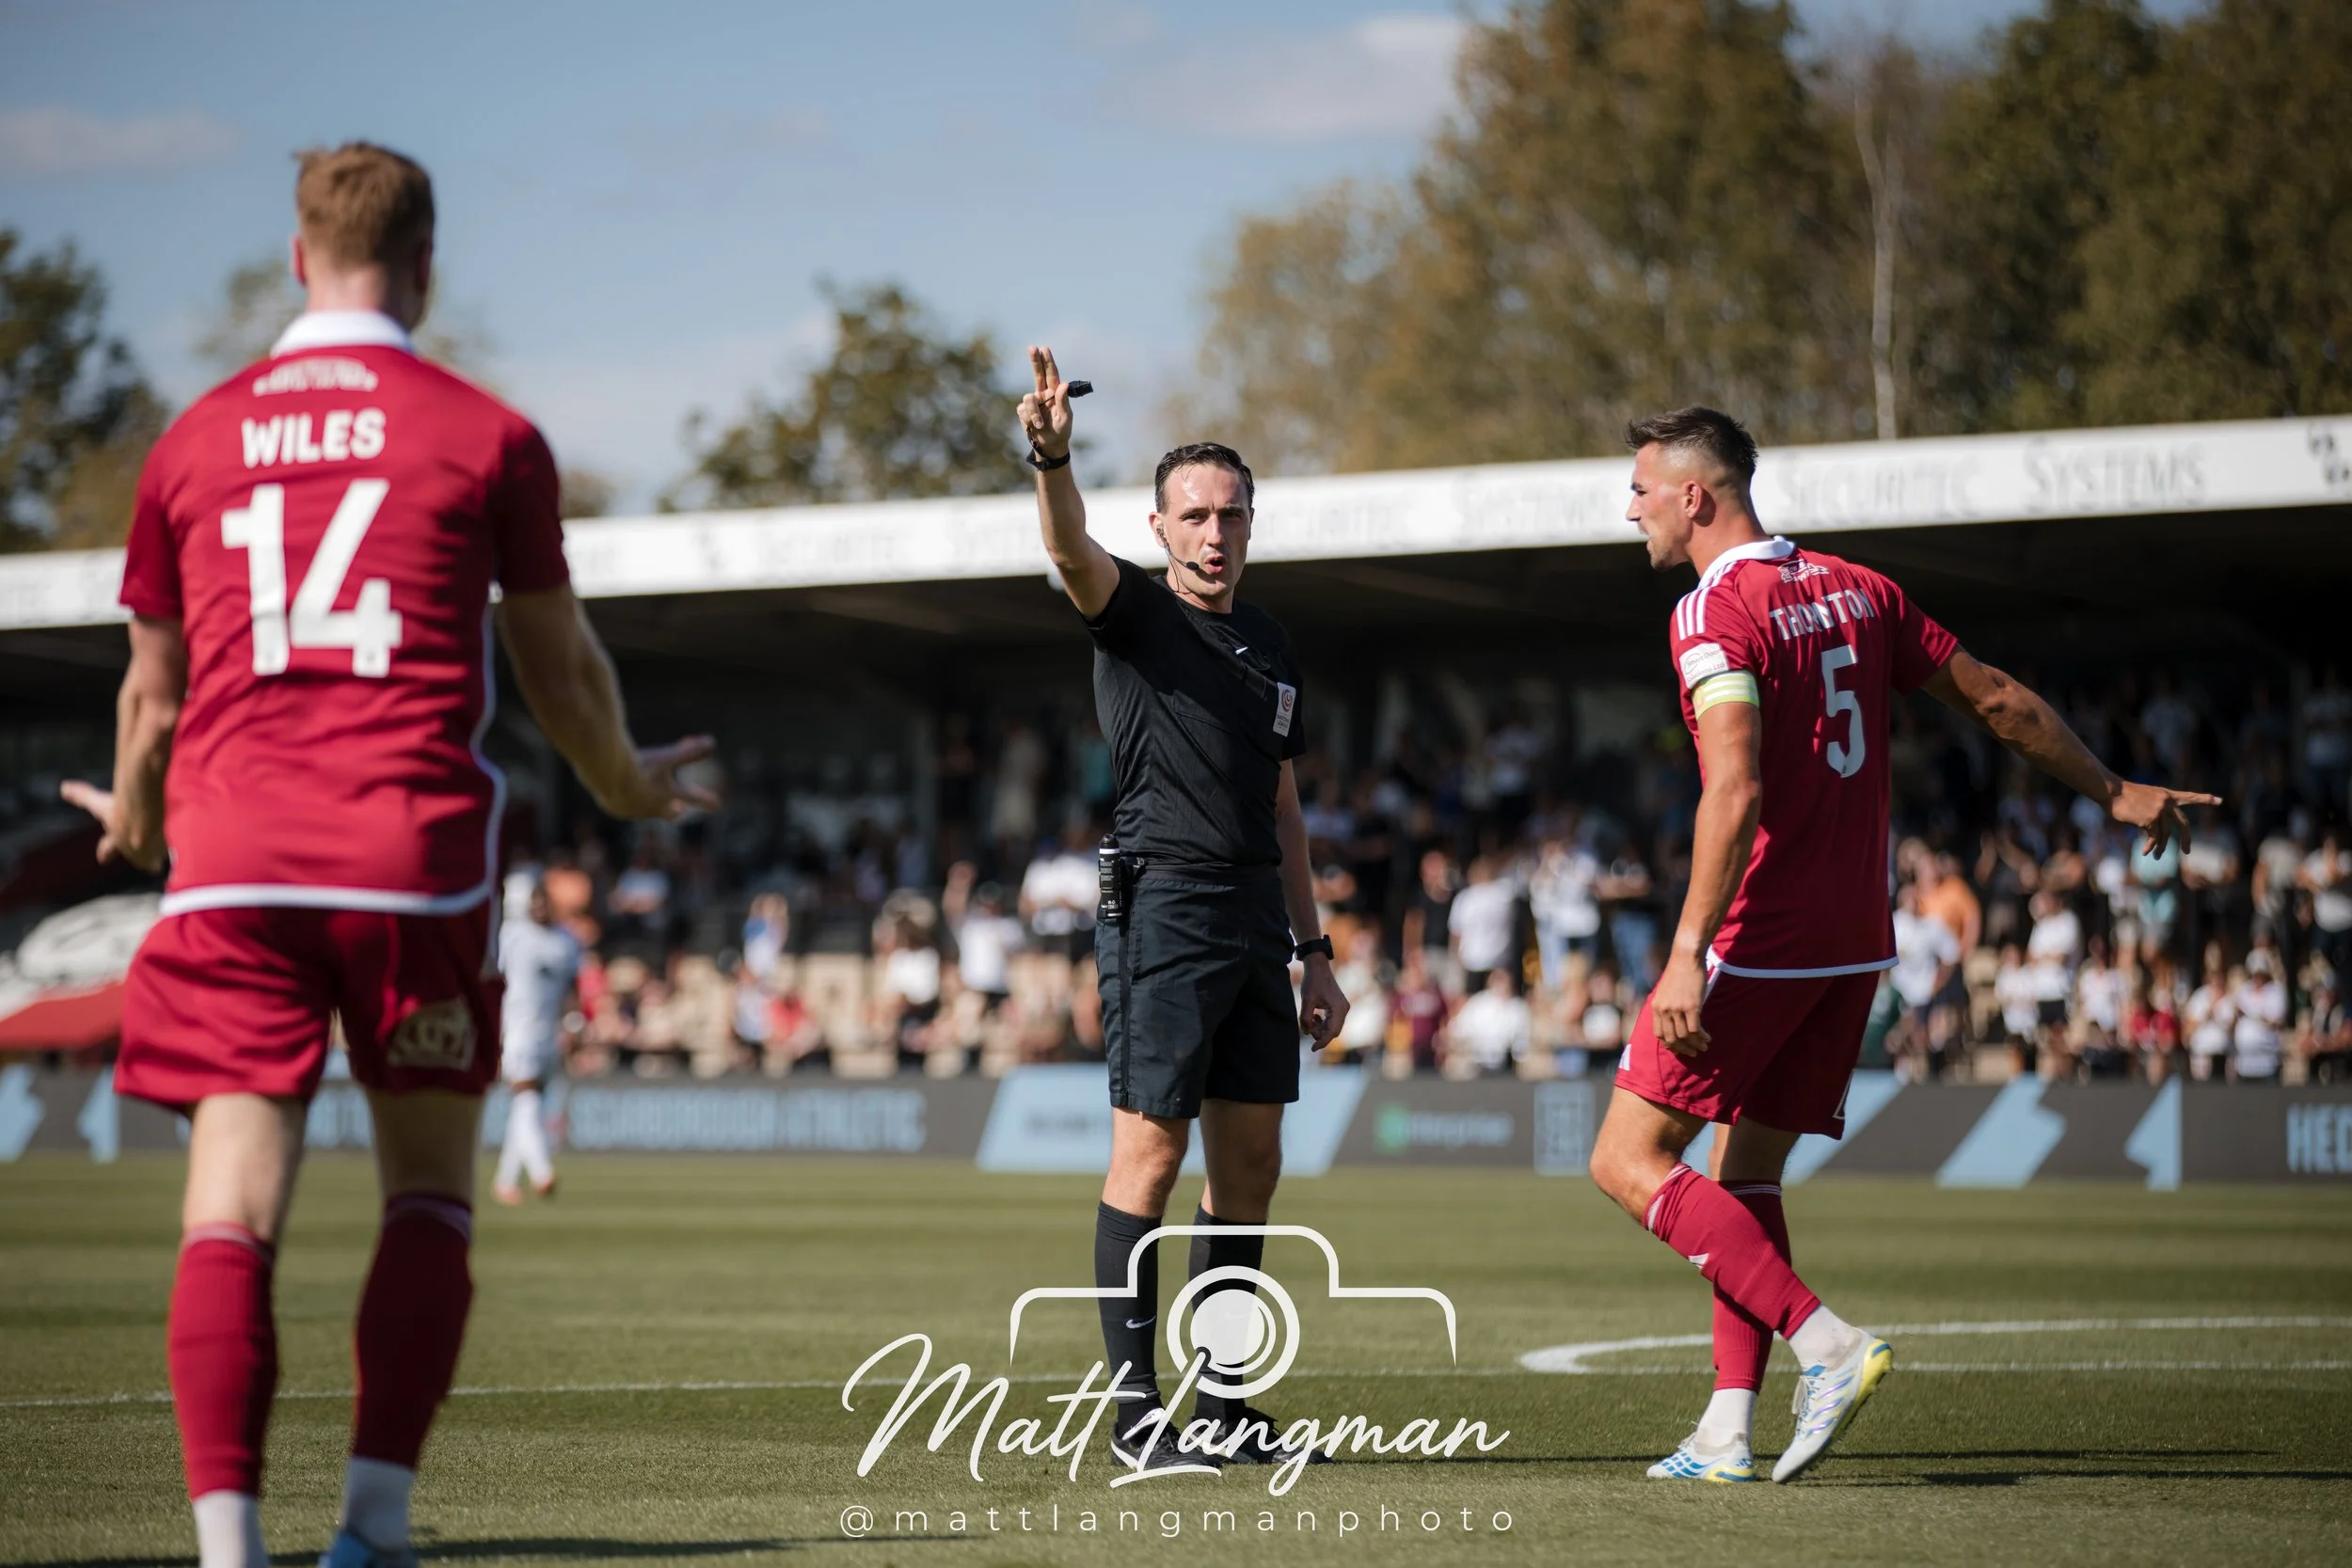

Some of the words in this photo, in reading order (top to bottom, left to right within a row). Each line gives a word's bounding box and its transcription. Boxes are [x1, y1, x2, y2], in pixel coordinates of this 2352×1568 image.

[242, 408, 386, 467] WILES
[2019, 438, 2209, 514] SYSTEMS
[221, 479, 402, 677] 14
[1821, 644, 1866, 778] 5
